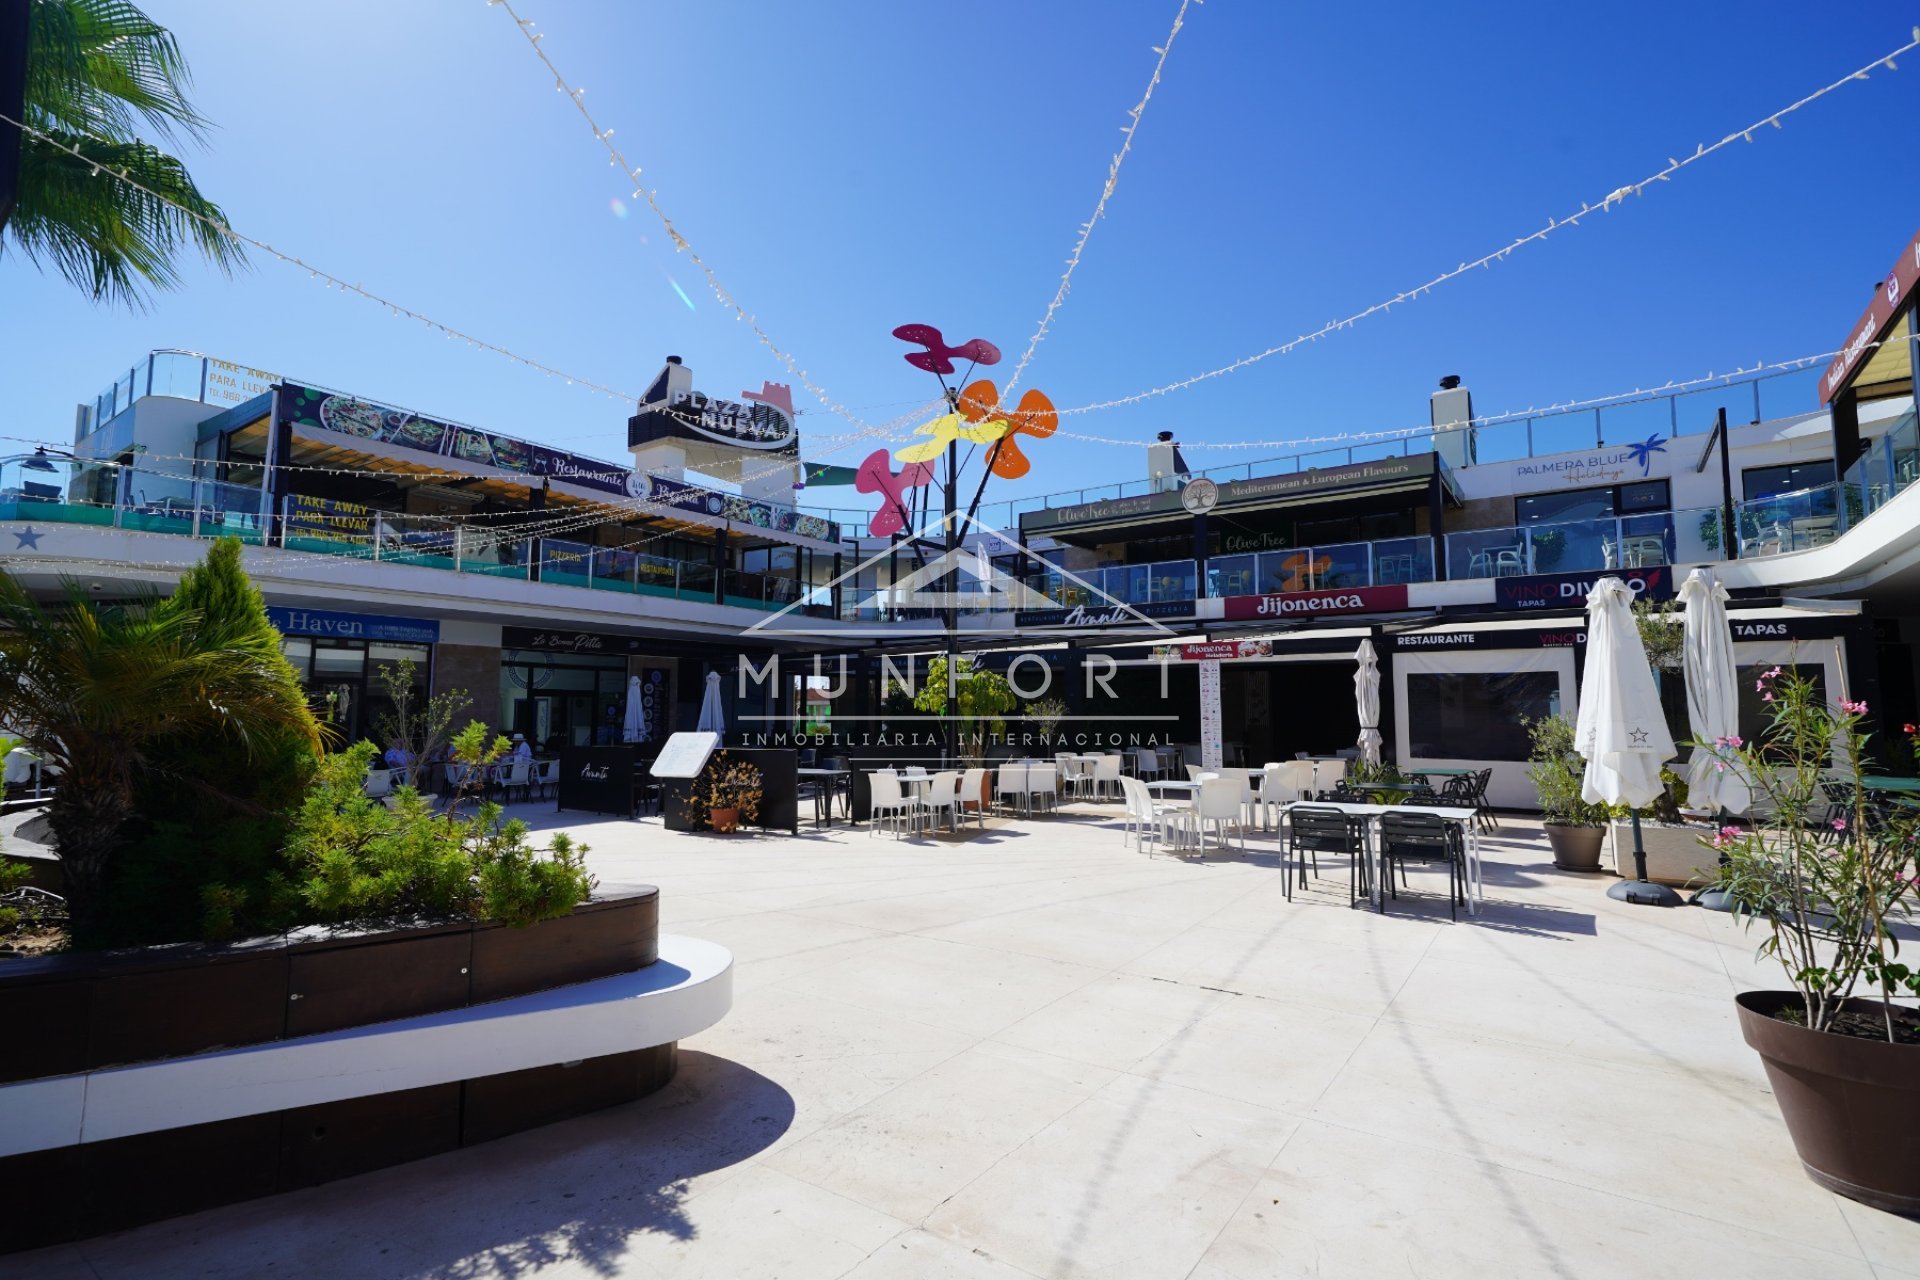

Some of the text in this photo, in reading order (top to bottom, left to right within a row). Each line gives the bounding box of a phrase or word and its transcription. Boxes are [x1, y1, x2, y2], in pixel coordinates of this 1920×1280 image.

[211, 359, 280, 382] TAKE AWAY
[209, 373, 269, 394] PARA LLEV
[674, 390, 752, 418] PLAZA
[701, 411, 778, 439] NUEVA
[552, 456, 623, 487] Restaurante
[1518, 453, 1629, 477] PALMERA BLUE
[1562, 466, 1625, 483] Holidays
[1231, 463, 1409, 497] Mediterranean & European Flavours
[295, 494, 368, 516] TAKE AWAY
[295, 510, 368, 531] PARA LLEVAR
[1226, 531, 1287, 551] Olive Tree
[640, 563, 675, 577] RESTAURANTE
[1256, 593, 1366, 617] Jijonenca
[1517, 599, 1546, 608] TAPAS
[287, 610, 364, 635] Haven
[1064, 604, 1131, 627] Avanti
[1397, 634, 1475, 646] RESTAURANTE
[1735, 624, 1788, 636] TAPAS
[531, 633, 545, 646] La
[573, 634, 603, 652] Pitta
[1186, 643, 1233, 655] Jijonenca
[580, 762, 610, 780] Avanti
